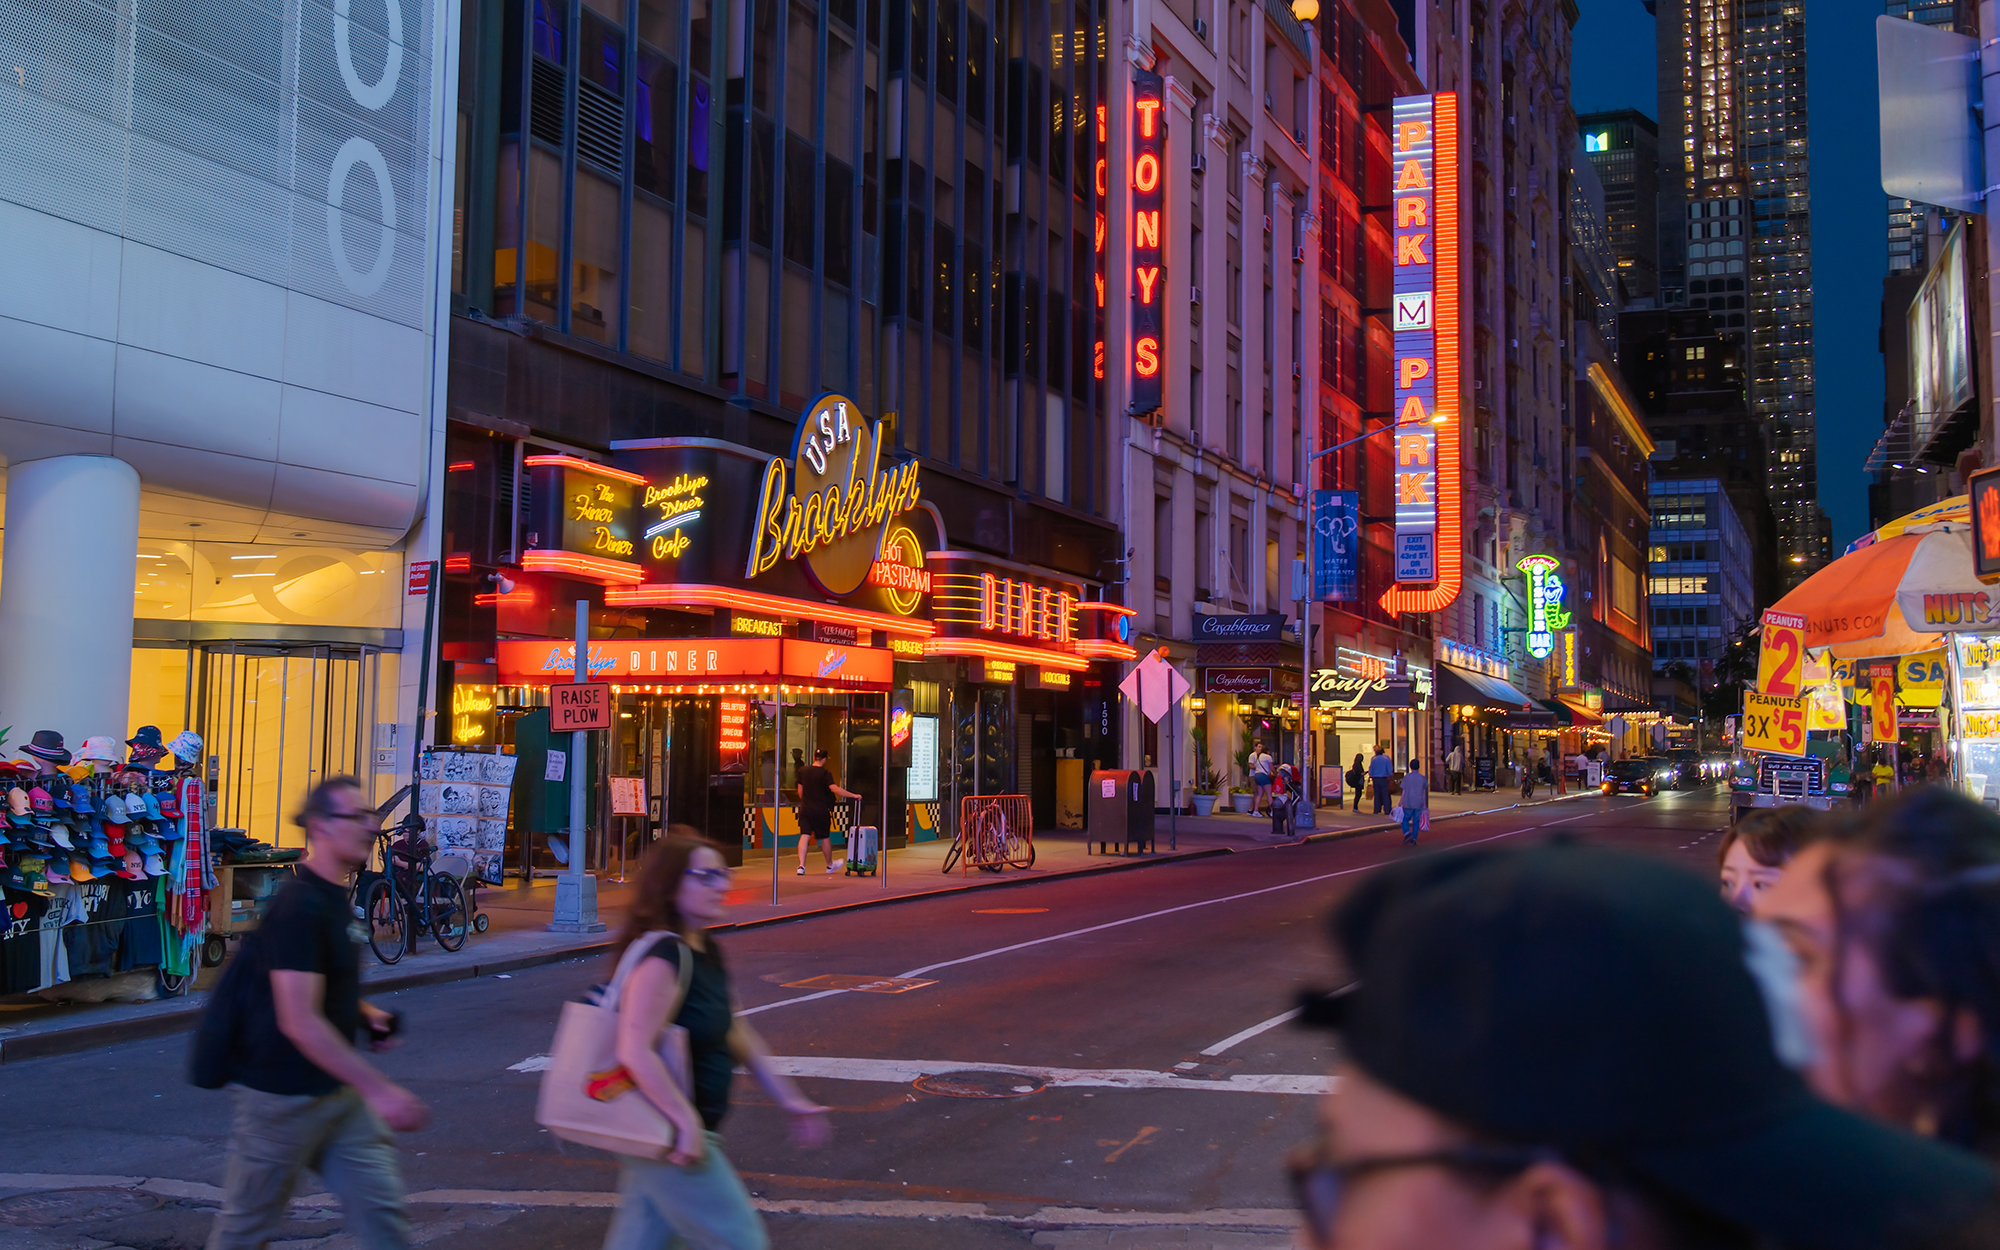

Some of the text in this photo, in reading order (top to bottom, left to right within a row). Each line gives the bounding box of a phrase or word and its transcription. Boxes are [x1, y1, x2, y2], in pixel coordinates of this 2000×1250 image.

[1397, 121, 1429, 266] PARK
[805, 402, 851, 476] USA
[1399, 358, 1431, 504] PARK
[597, 484, 614, 502] The
[642, 473, 708, 507] Brooklyn
[748, 420, 920, 578] Brooklyn
[576, 495, 613, 523] Finer
[660, 496, 704, 519] Diner
[595, 526, 633, 555] Diner
[652, 528, 691, 559] Cafe
[884, 542, 902, 562] HOT
[876, 564, 930, 592] PASTRAMI
[981, 572, 1070, 643] DINER
[736, 617, 782, 636] BREAKFAST
[1202, 616, 1271, 635] Casablanca
[1766, 613, 1804, 629] PEANUTS
[894, 639, 924, 655] BURGERS
[1529, 633, 1551, 648] BAR
[630, 650, 718, 671] DINER
[1361, 655, 1387, 680] PARK
[1870, 667, 1880, 676] HOT
[1215, 673, 1261, 686] Casablanca
[1310, 668, 1390, 708] Tony's
[453, 684, 492, 715] Welcome
[561, 689, 600, 705] RAISE
[1750, 694, 1802, 708] PEANUTS
[564, 708, 598, 723] PLOW
[1966, 714, 1988, 735] Nuts
[1747, 707, 1803, 751] 3X $5
[652, 803, 658, 815] A
